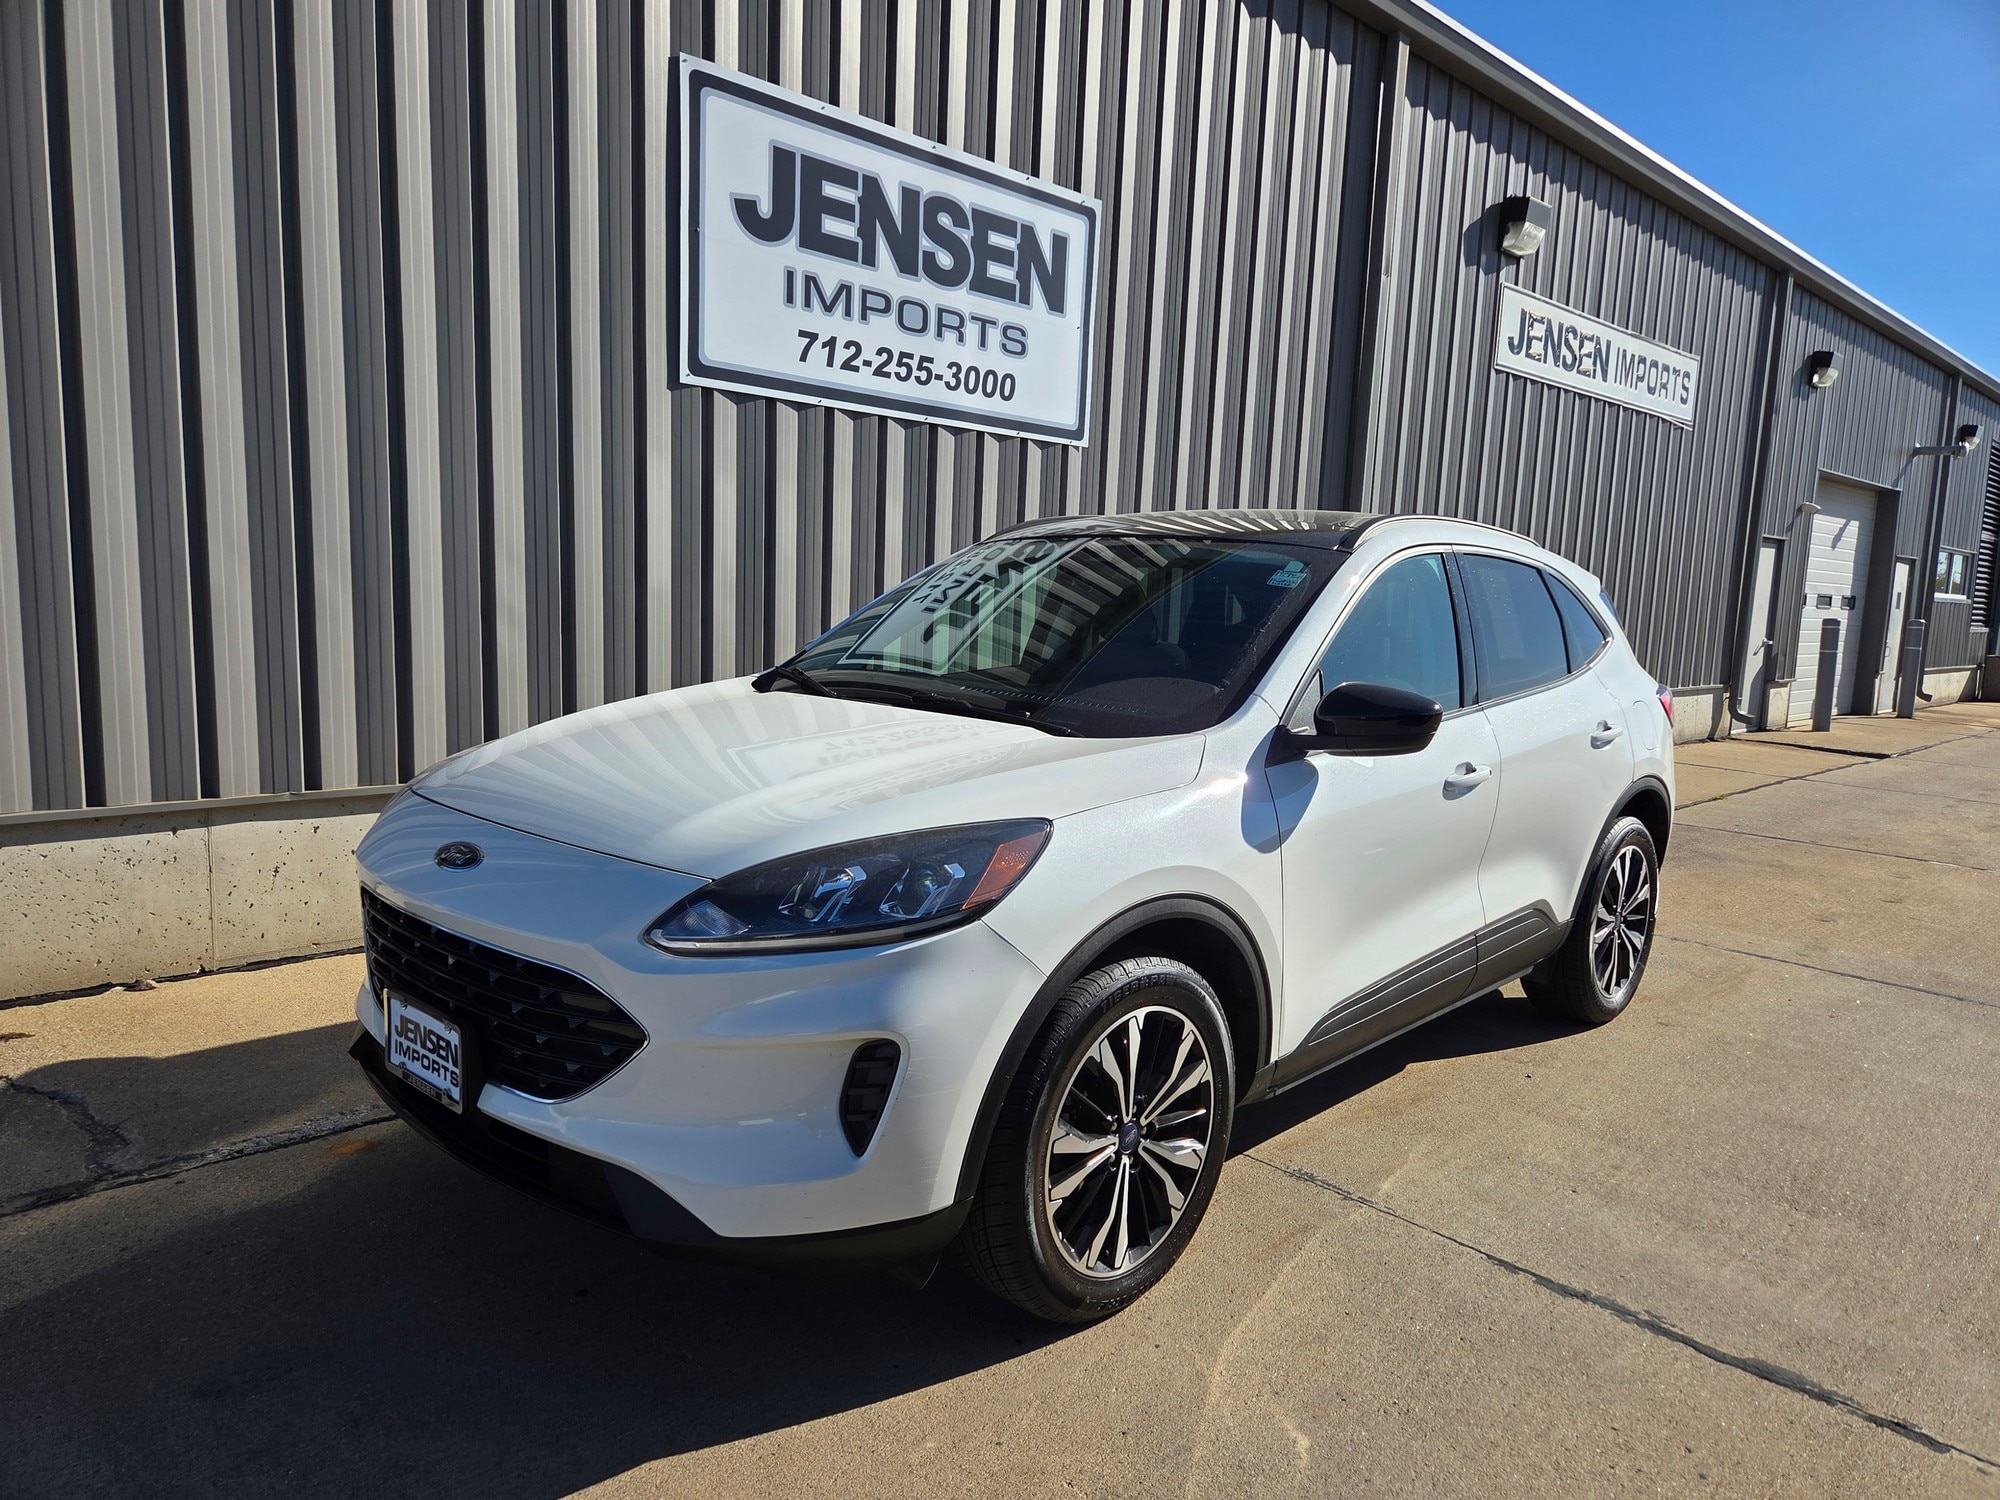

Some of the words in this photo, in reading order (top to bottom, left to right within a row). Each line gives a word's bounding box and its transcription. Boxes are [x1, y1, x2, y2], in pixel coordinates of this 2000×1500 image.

[730, 140, 1069, 317] JENSEN
[784, 266, 1028, 358] IMPORTS
[798, 330, 1017, 402] 712-255-3000
[1508, 307, 1611, 383] JENSEN
[1614, 346, 1691, 405] IMPORTS
[395, 1014, 459, 1069] JENSEN
[395, 1039, 459, 1088] IMPORTS
